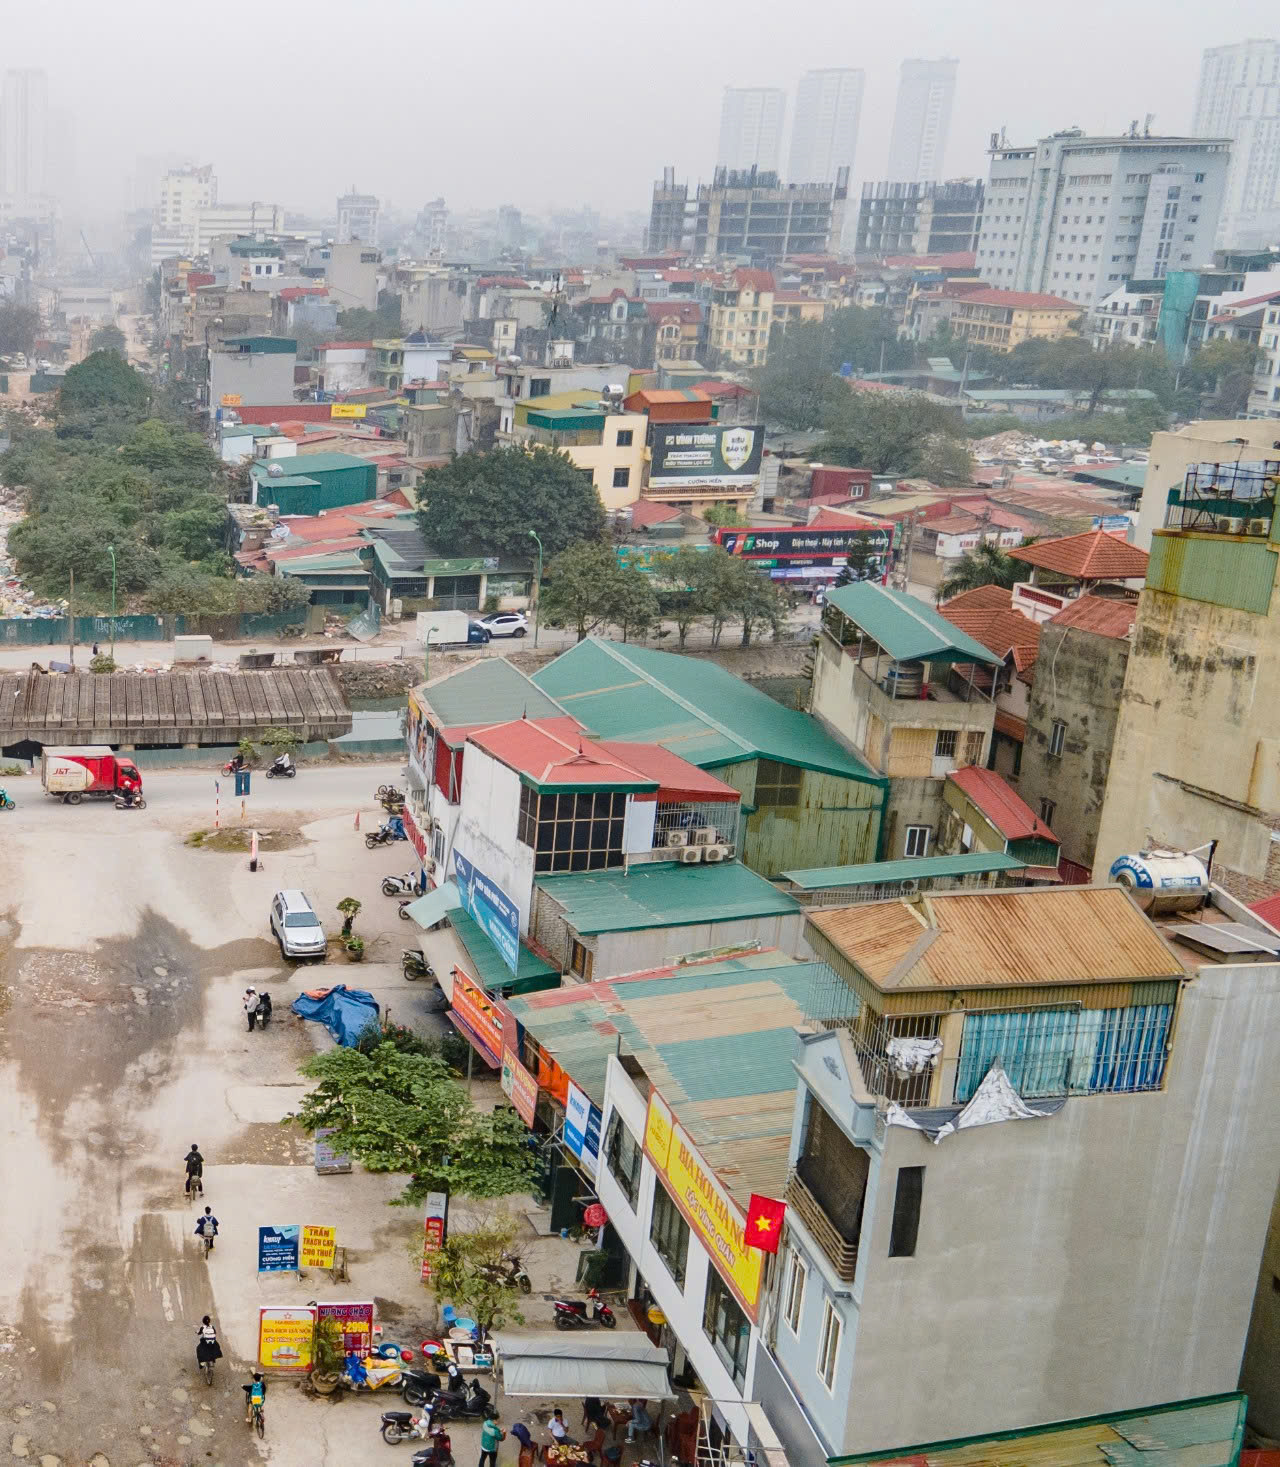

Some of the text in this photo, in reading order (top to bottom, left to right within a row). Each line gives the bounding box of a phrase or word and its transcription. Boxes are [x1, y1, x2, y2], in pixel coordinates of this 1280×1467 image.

[679, 1142, 694, 1178] BIA
[695, 1167, 715, 1207] HƠI
[715, 1195, 730, 1233] HÀ
